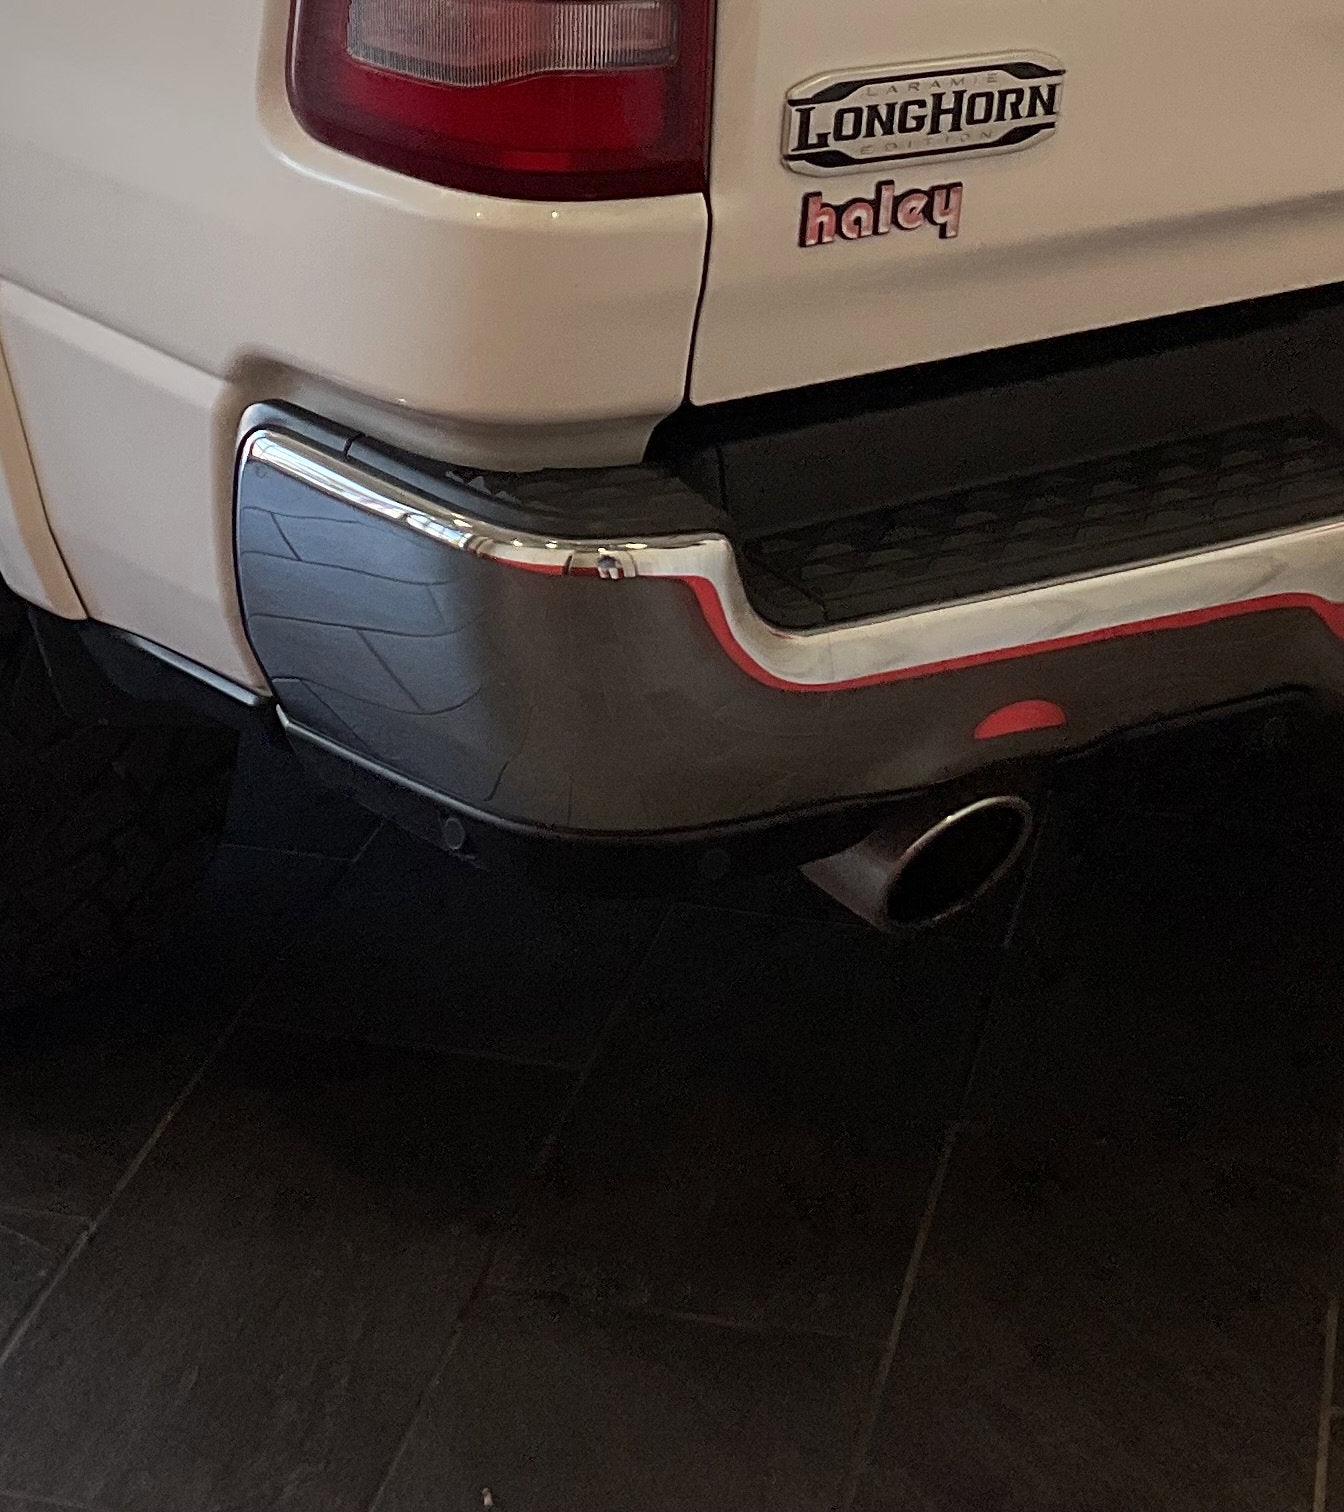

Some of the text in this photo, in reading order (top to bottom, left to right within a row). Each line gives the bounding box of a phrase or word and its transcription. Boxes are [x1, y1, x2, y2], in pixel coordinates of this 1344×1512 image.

[866, 72, 999, 97] LARAMIE
[860, 130, 993, 155] EDITION
[799, 179, 963, 248] haley
